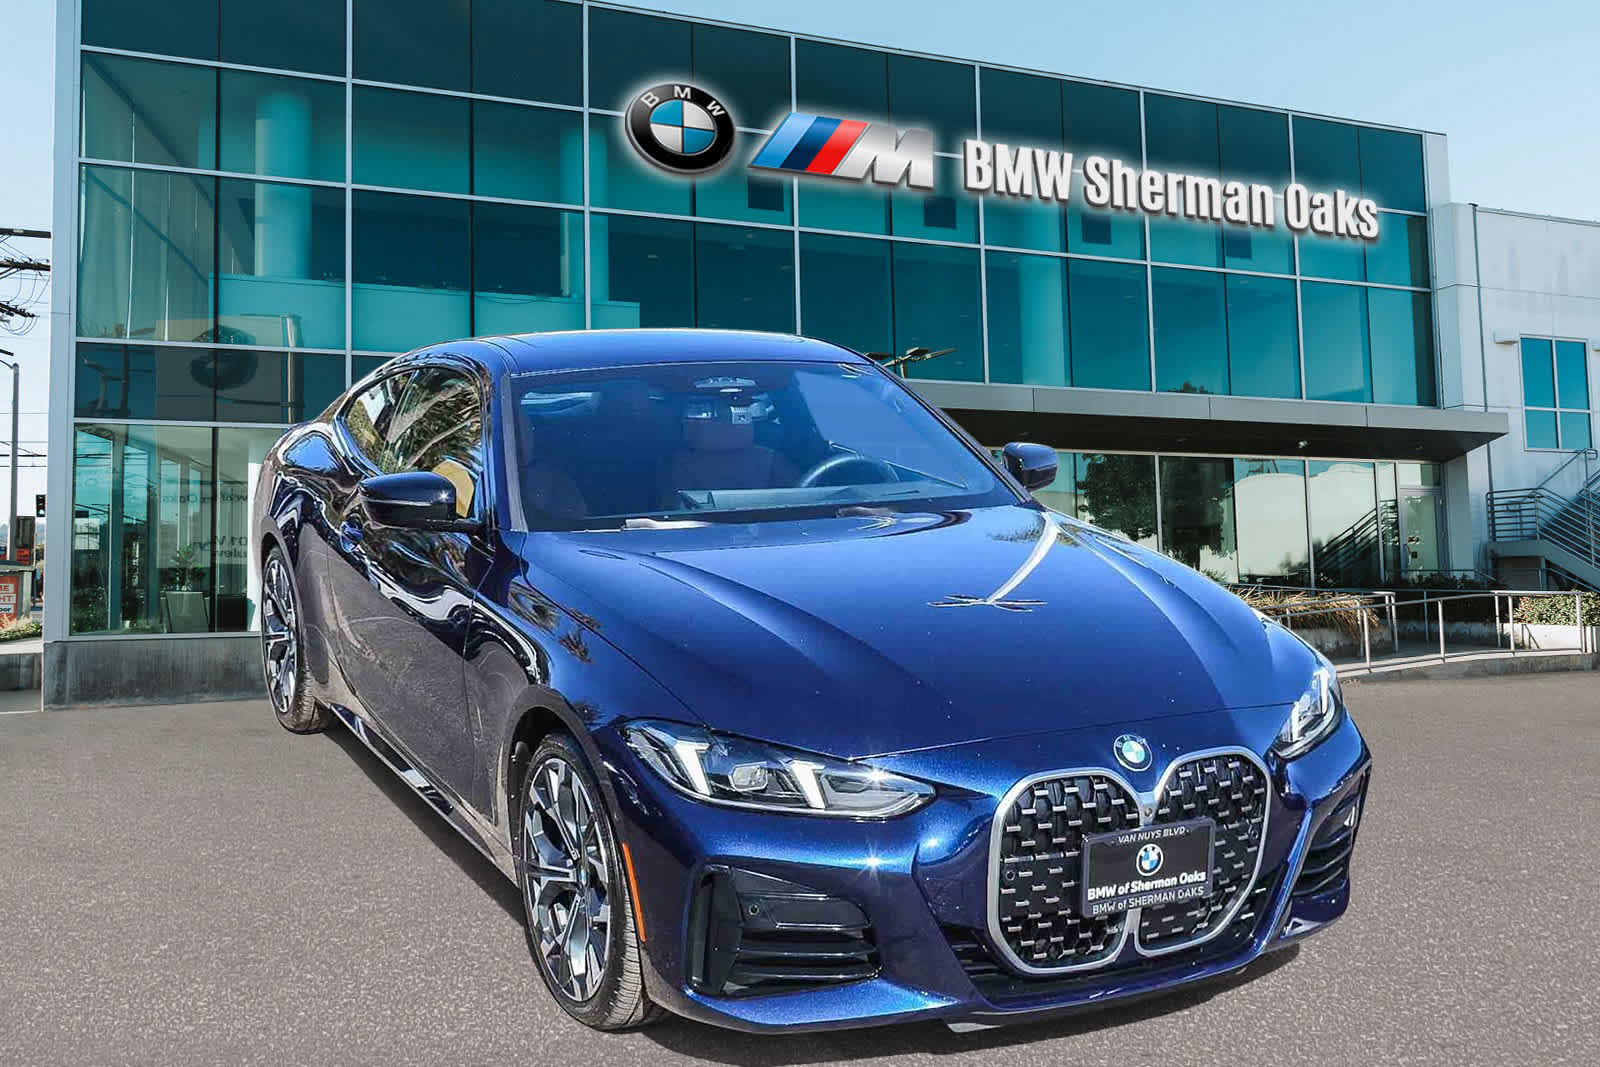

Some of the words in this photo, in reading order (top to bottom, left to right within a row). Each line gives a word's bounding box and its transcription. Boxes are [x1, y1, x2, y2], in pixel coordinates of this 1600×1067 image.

[964, 139, 1073, 201] BMW
[1083, 155, 1275, 226] Sherman
[1284, 182, 1380, 242] Oaks
[1118, 834, 1137, 844] VAN
[1137, 829, 1162, 841] NUYS
[1087, 883, 1117, 900] BMW
[1118, 880, 1130, 895] of
[1130, 875, 1177, 893] Sherman
[1179, 870, 1206, 884] Oaks
[1092, 902, 1116, 915] BMW
[1117, 900, 1127, 910] of
[1129, 892, 1176, 907] SHERMAN
[1177, 886, 1204, 899] OAKS
